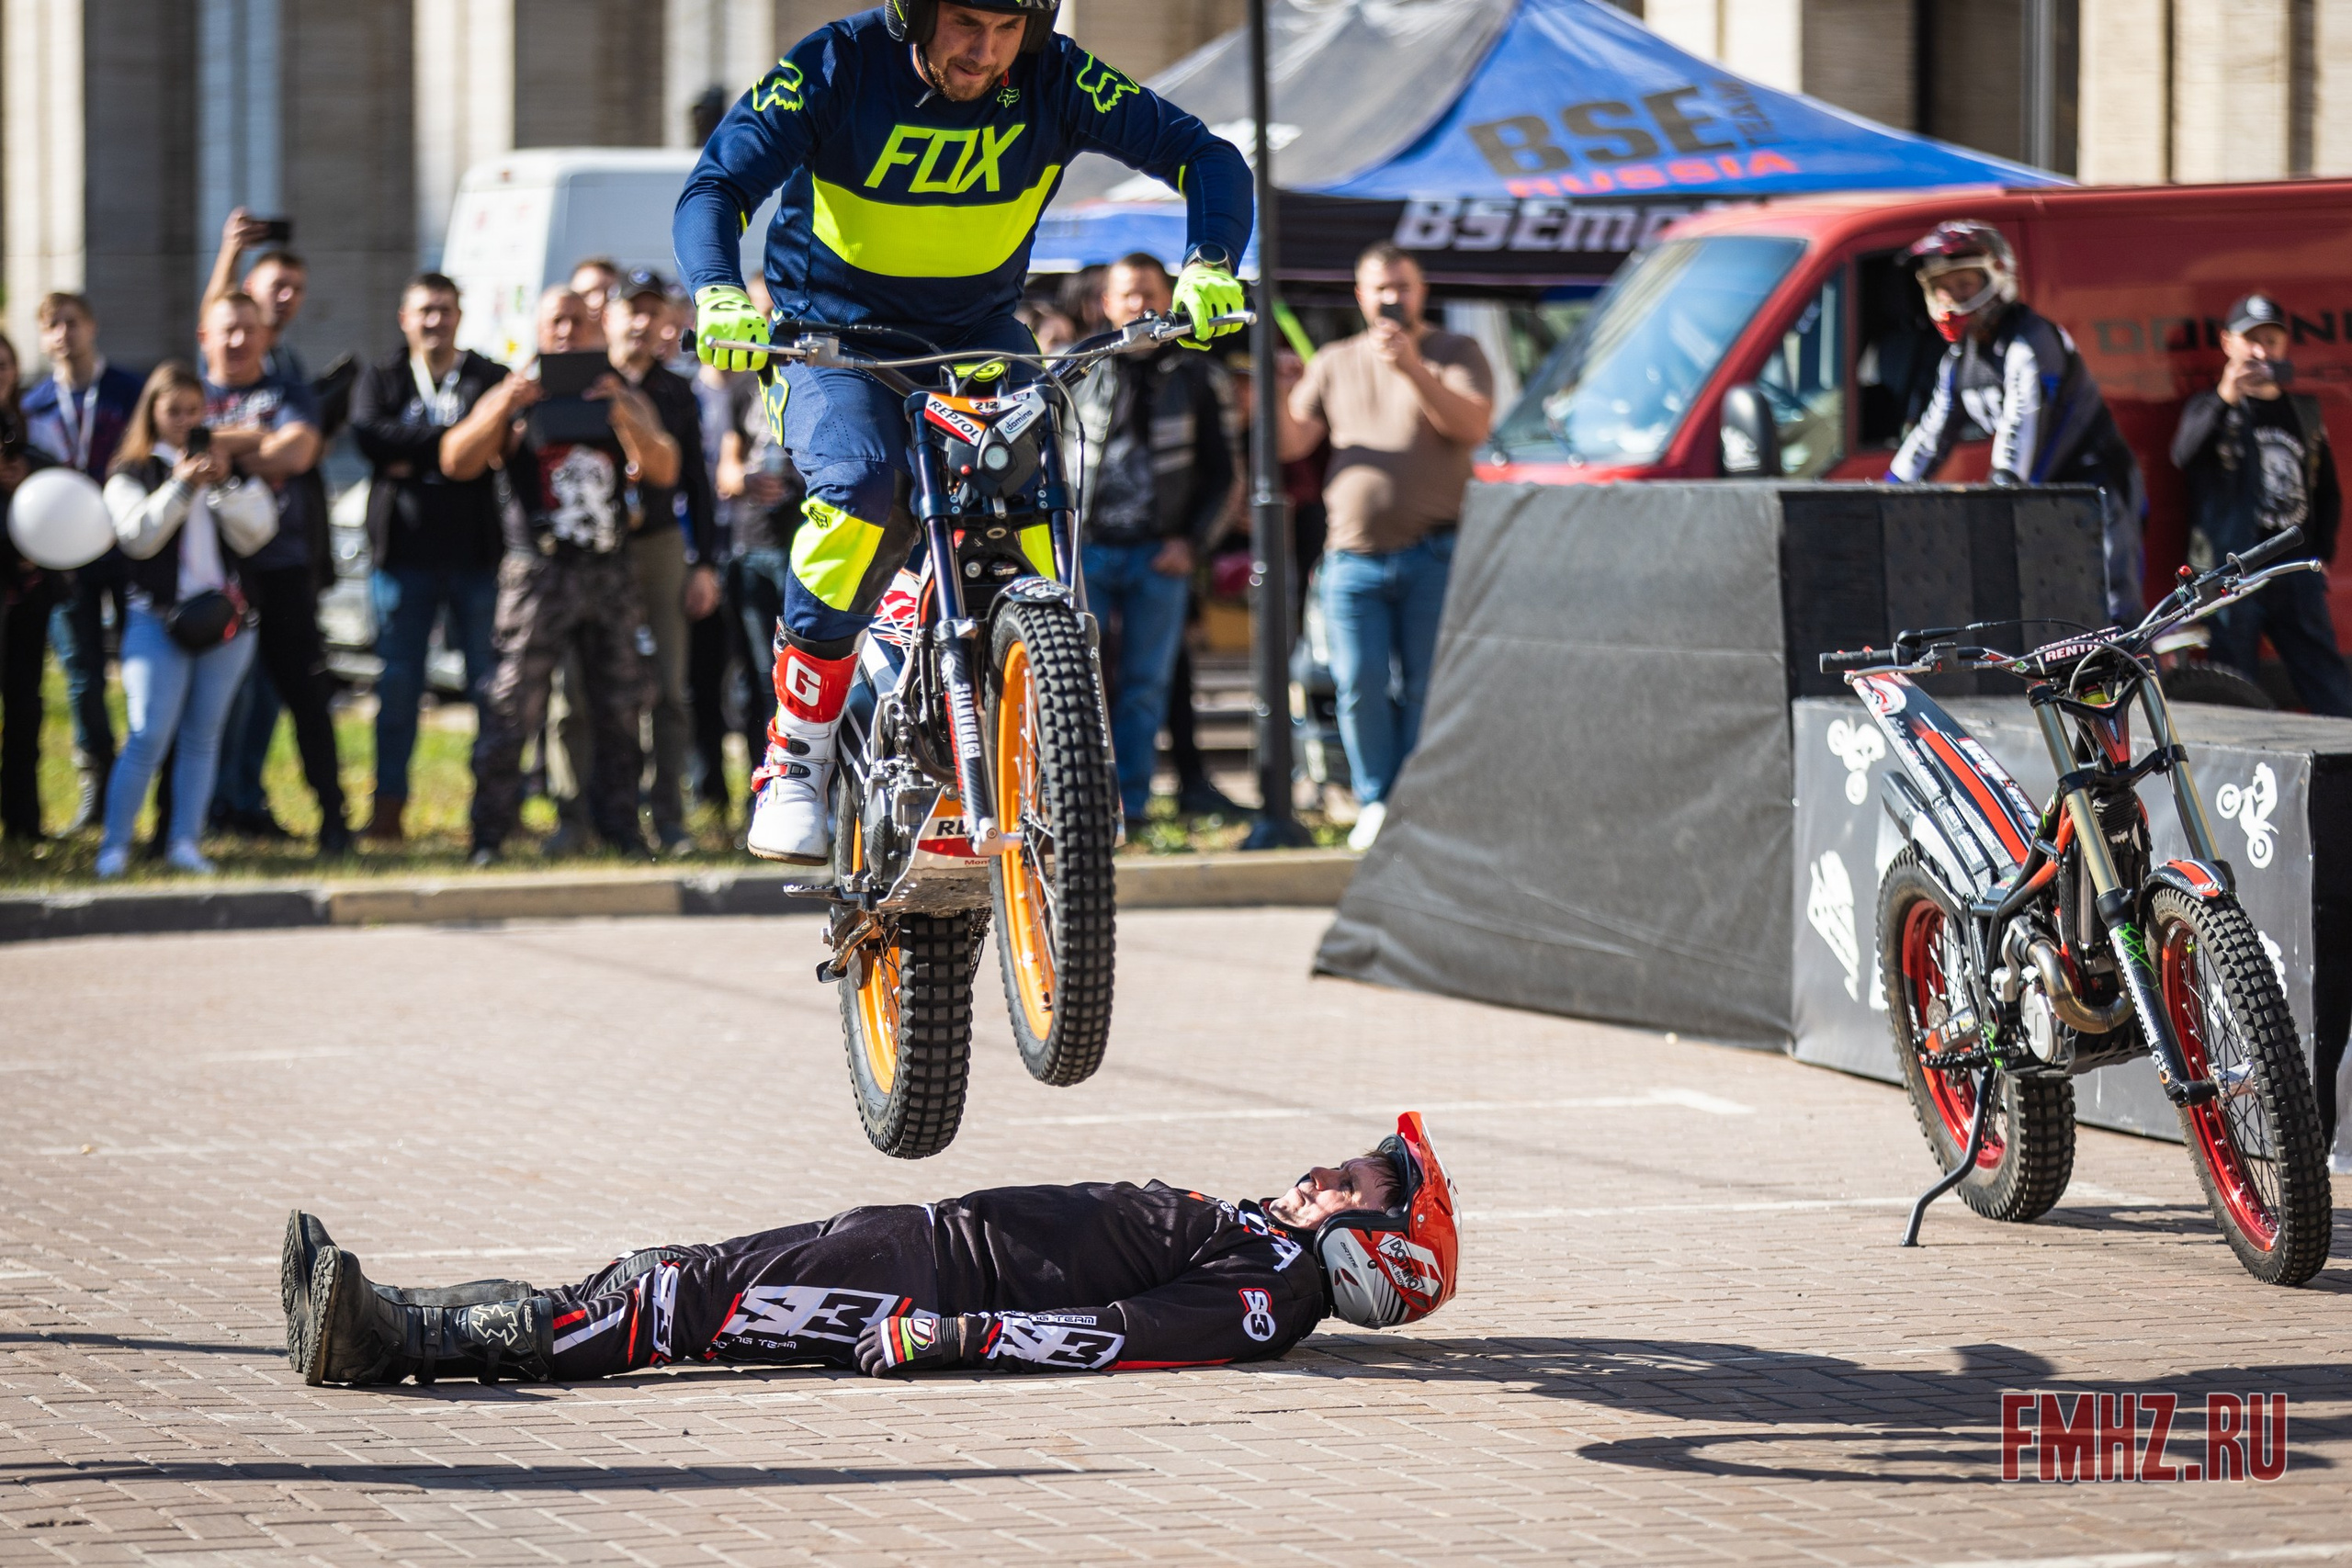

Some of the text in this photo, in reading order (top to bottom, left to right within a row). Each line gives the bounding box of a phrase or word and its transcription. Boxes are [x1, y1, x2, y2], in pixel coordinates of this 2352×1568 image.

[1465, 86, 1737, 176] BSE
[864, 123, 1026, 194] FOX
[1505, 149, 1801, 197] RUSSIA
[928, 400, 982, 440] REPSOL
[1005, 410, 1035, 431] domino
[1386, 1251, 1407, 1288] TRIAL SHOW
[1389, 1240, 1419, 1290] DOMINO
[1054, 1315, 1094, 1324] TEAM
[758, 1338, 797, 1349] TEAM
